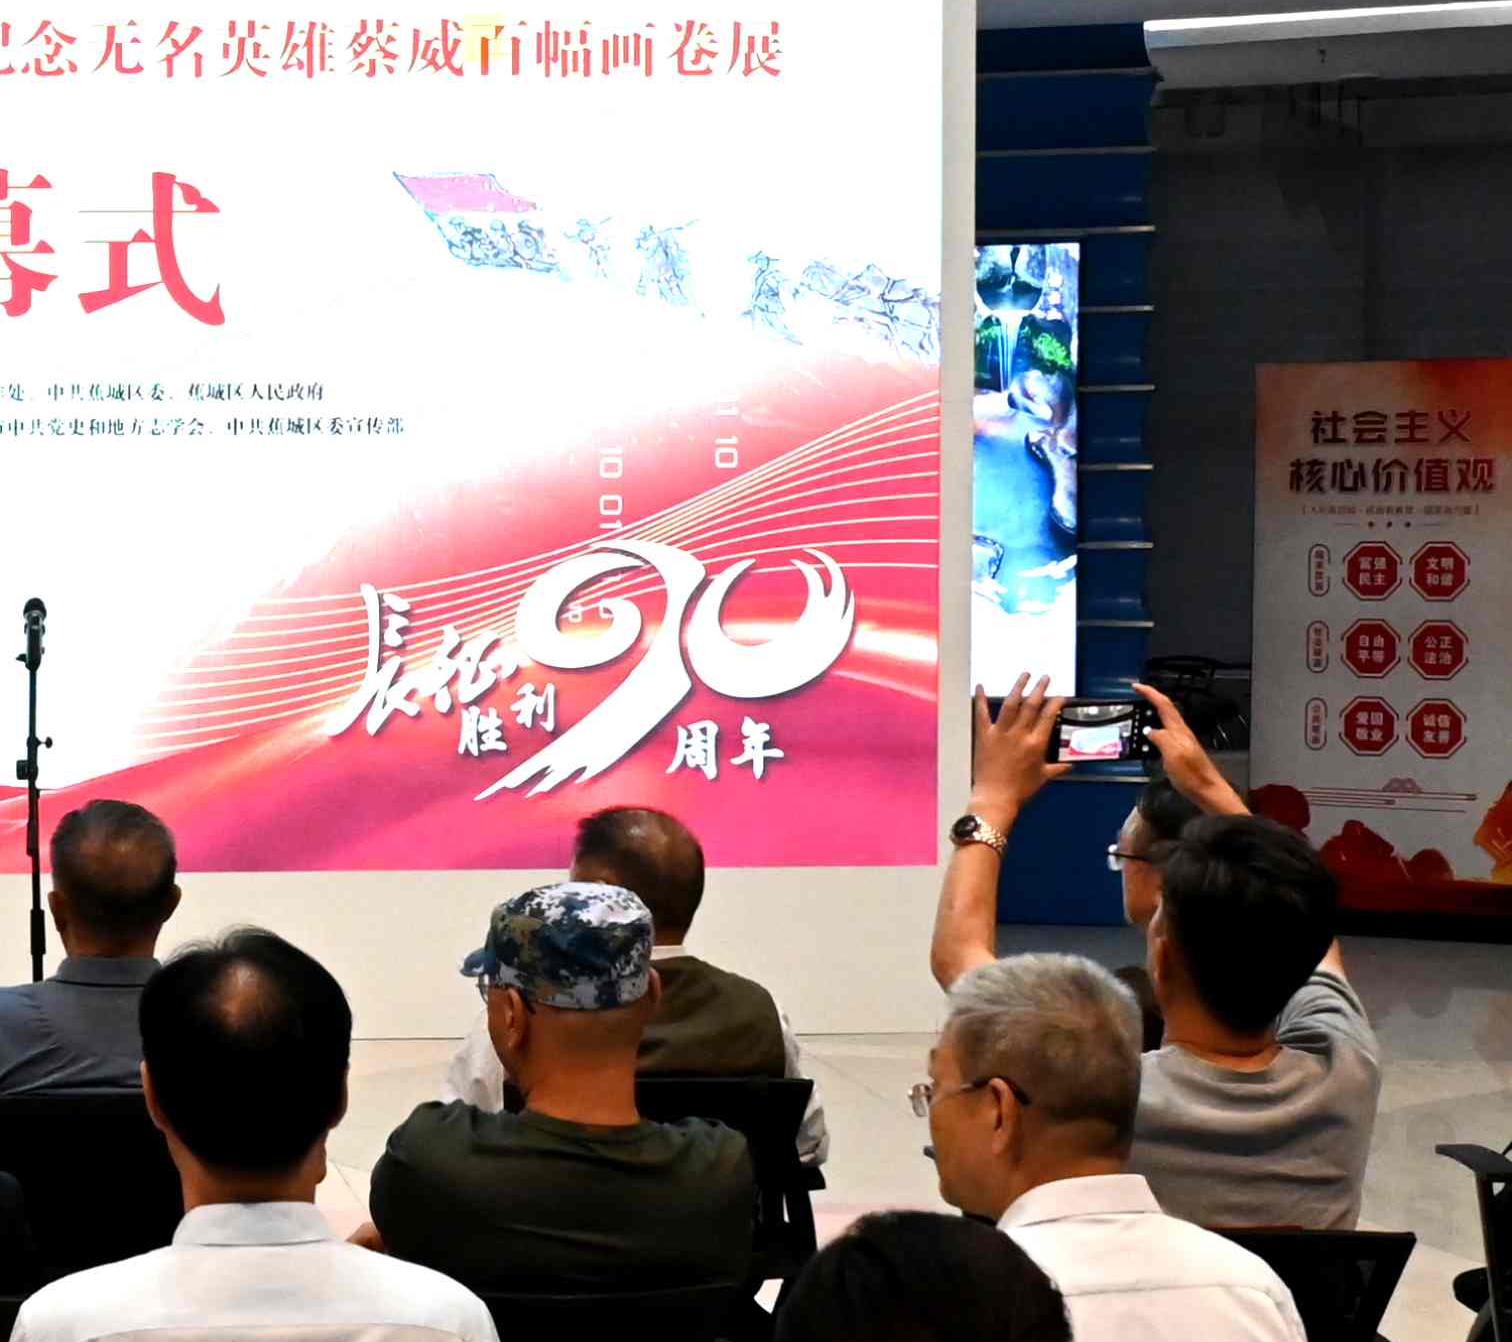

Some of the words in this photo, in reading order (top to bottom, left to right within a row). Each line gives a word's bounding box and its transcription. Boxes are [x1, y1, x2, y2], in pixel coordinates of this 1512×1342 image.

[1311, 410, 1473, 444] 社会主义
[1289, 458, 1496, 493] 核心价值观
[1426, 557, 1454, 571] 文明
[1359, 573, 1387, 586] 民主
[1359, 635, 1385, 648] 自由
[1425, 636, 1453, 649] 公正
[457, 683, 556, 757] 胜利
[666, 717, 784, 779] 周年
